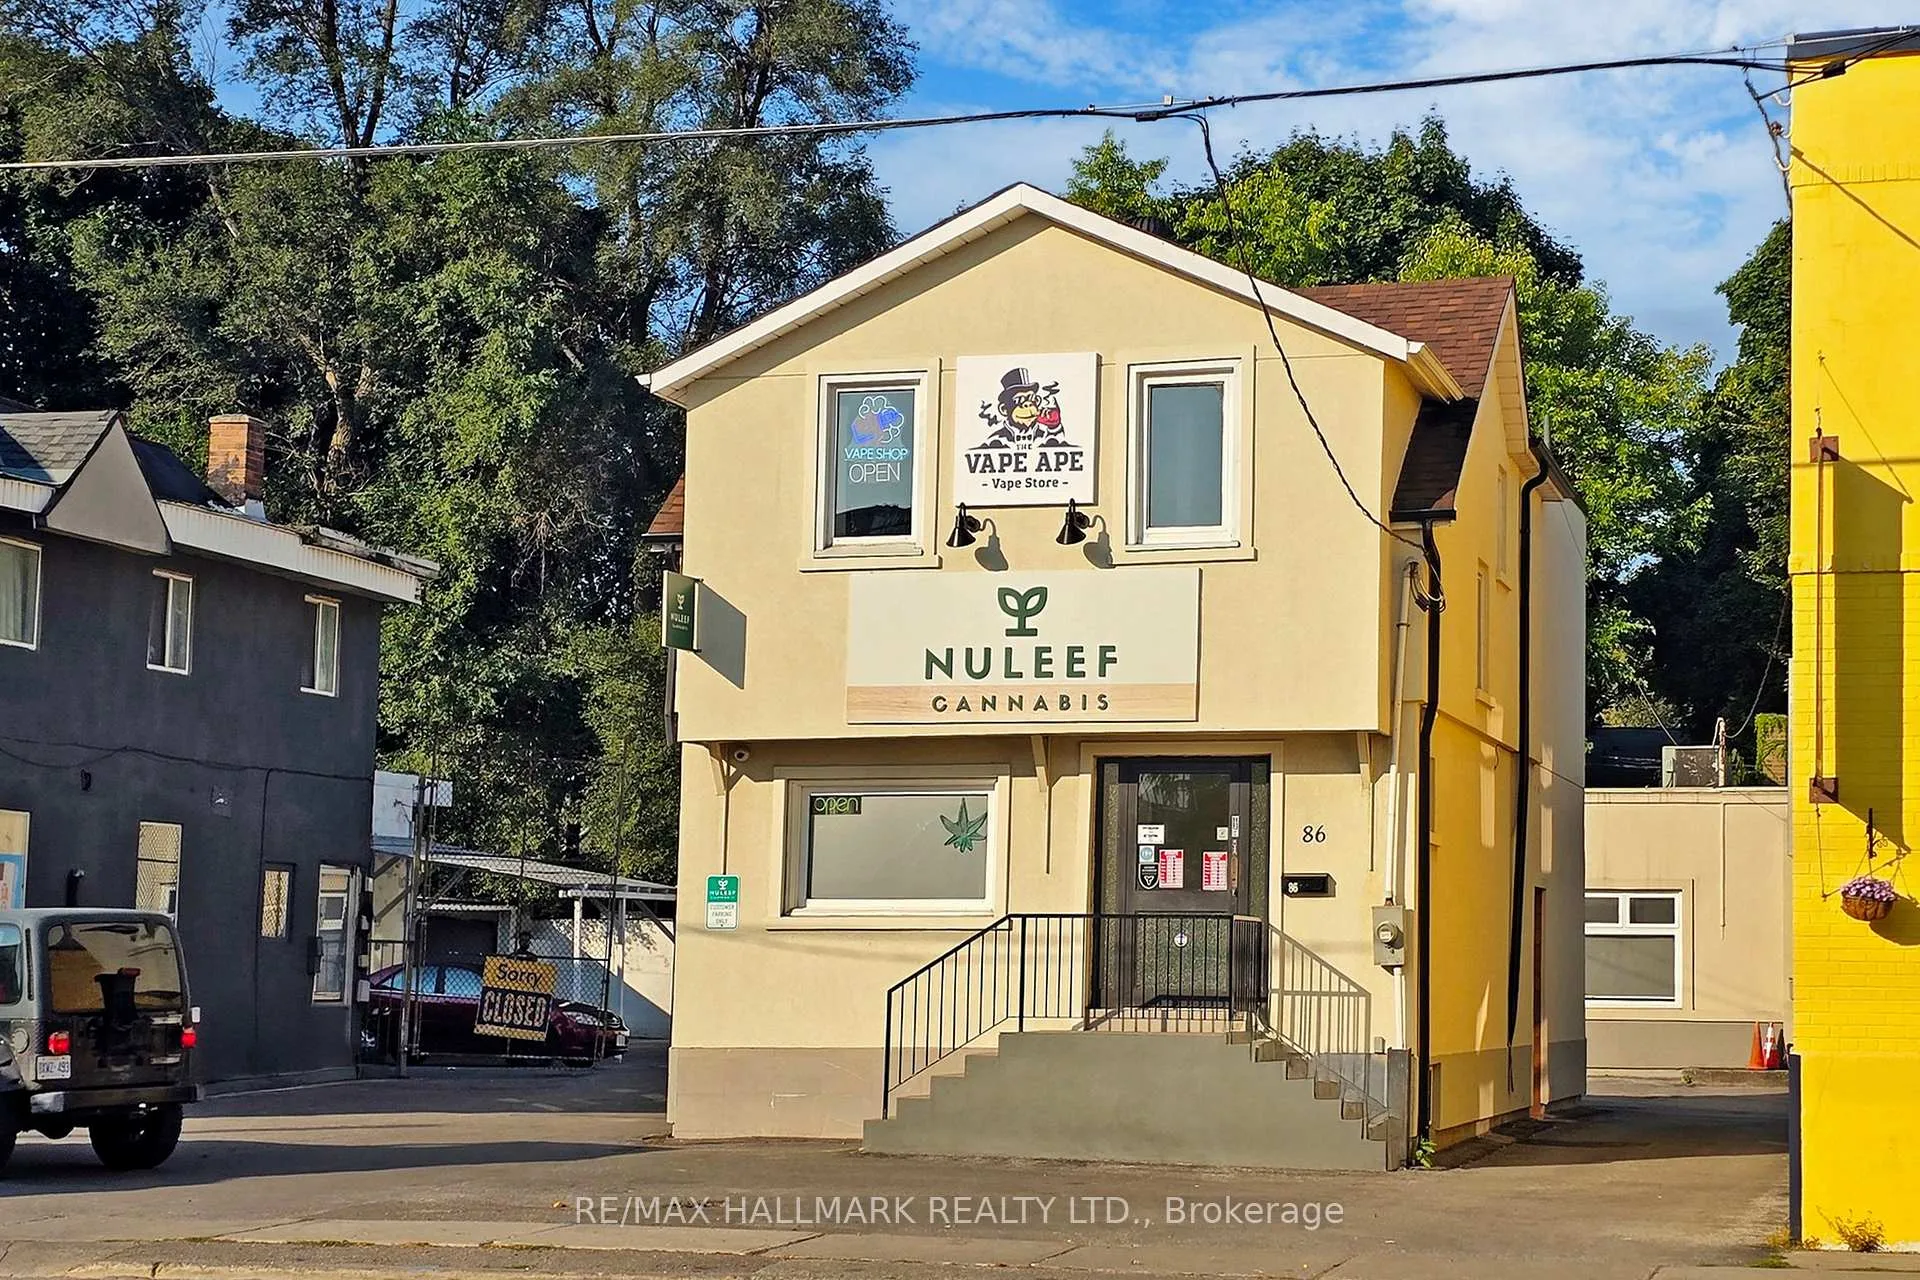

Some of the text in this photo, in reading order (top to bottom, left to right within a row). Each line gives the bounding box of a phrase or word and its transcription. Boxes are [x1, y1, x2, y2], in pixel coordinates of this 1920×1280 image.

[844, 447, 908, 461] VAPE SHOP
[964, 451, 1084, 474] VAPE APE
[849, 463, 901, 483] OPEN
[992, 477, 1059, 491] Vape Store
[924, 645, 1118, 680] NULEEF
[931, 694, 1109, 712] CANNABIS
[813, 797, 859, 815] open
[1302, 825, 1327, 843] 86
[496, 963, 542, 990] Sorry
[482, 990, 547, 1028] CLOSED
